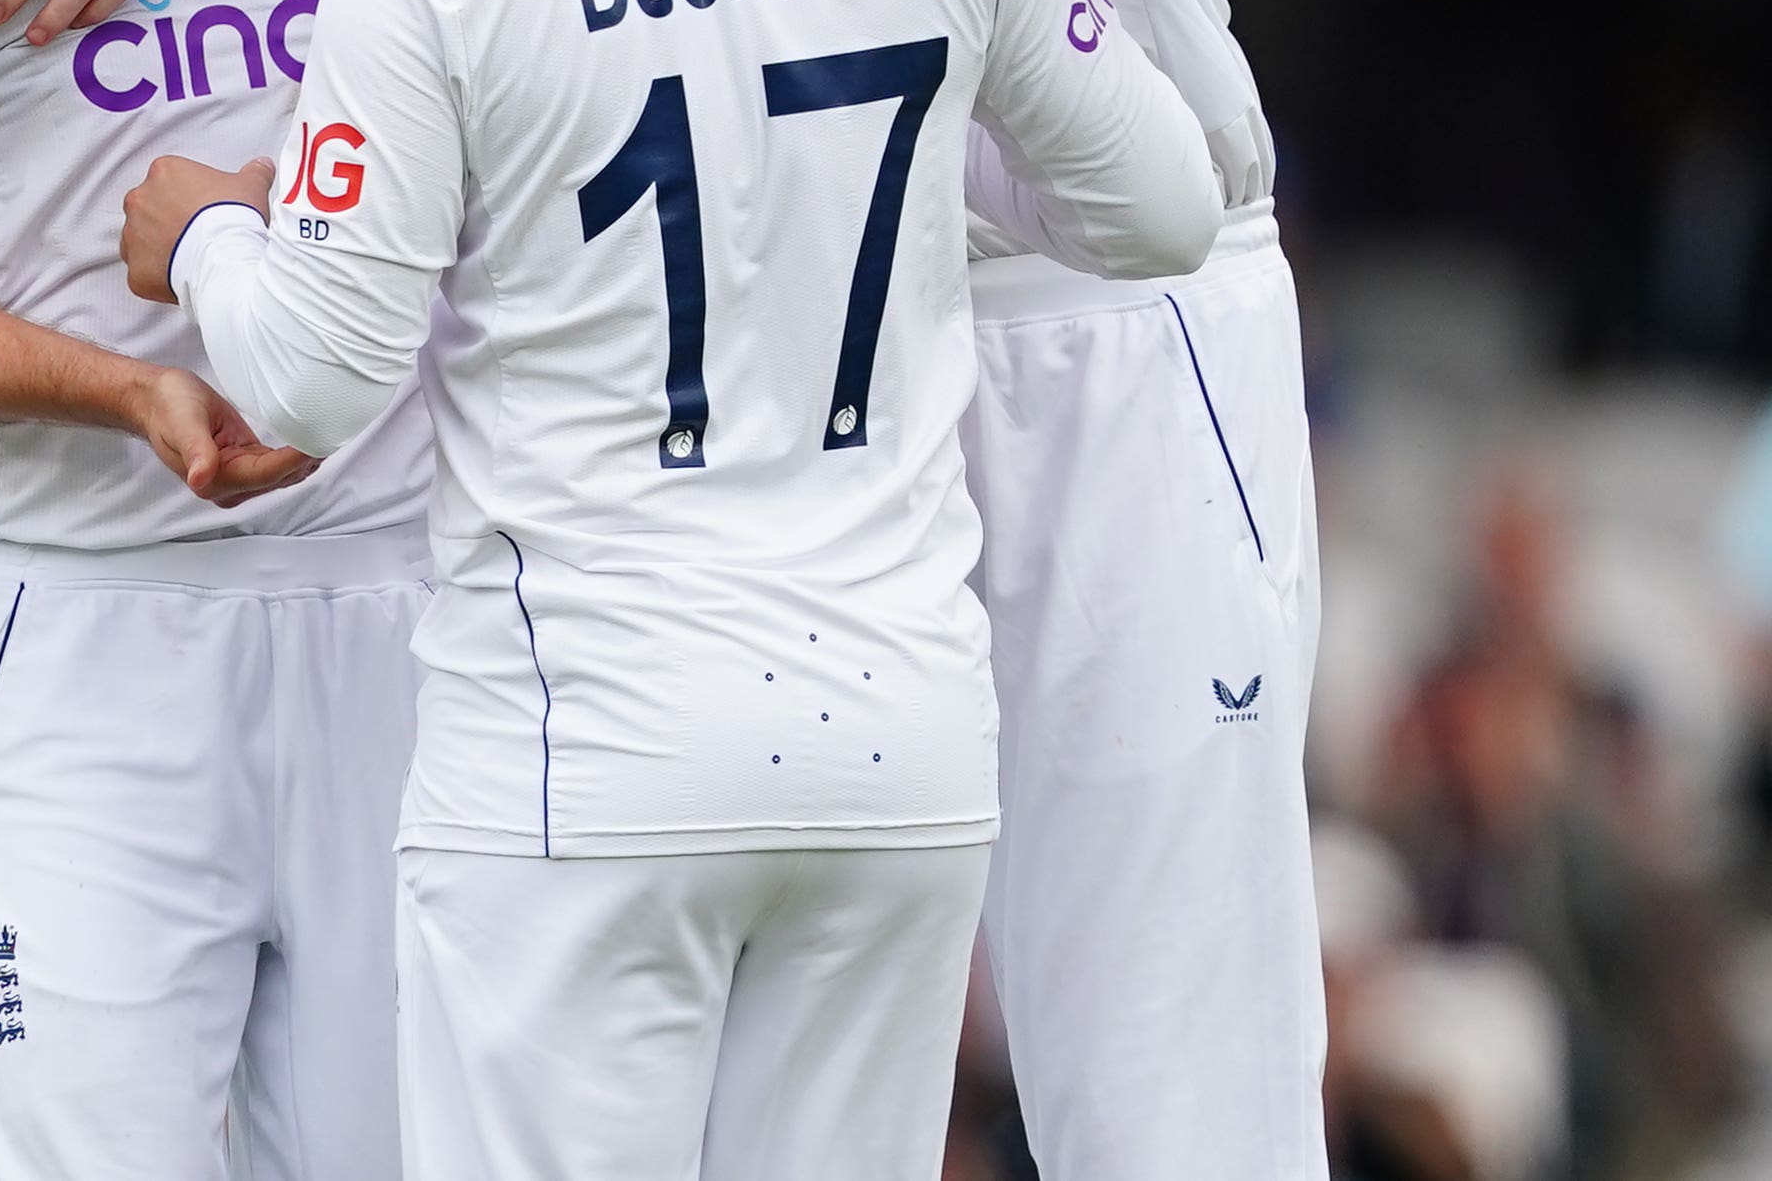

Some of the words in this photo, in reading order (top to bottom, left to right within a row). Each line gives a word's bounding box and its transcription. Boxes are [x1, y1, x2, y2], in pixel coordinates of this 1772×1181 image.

[282, 121, 366, 213] IG
[299, 218, 330, 241] BD
[576, 36, 949, 468] 17
[1215, 712, 1259, 724] CASTORE
